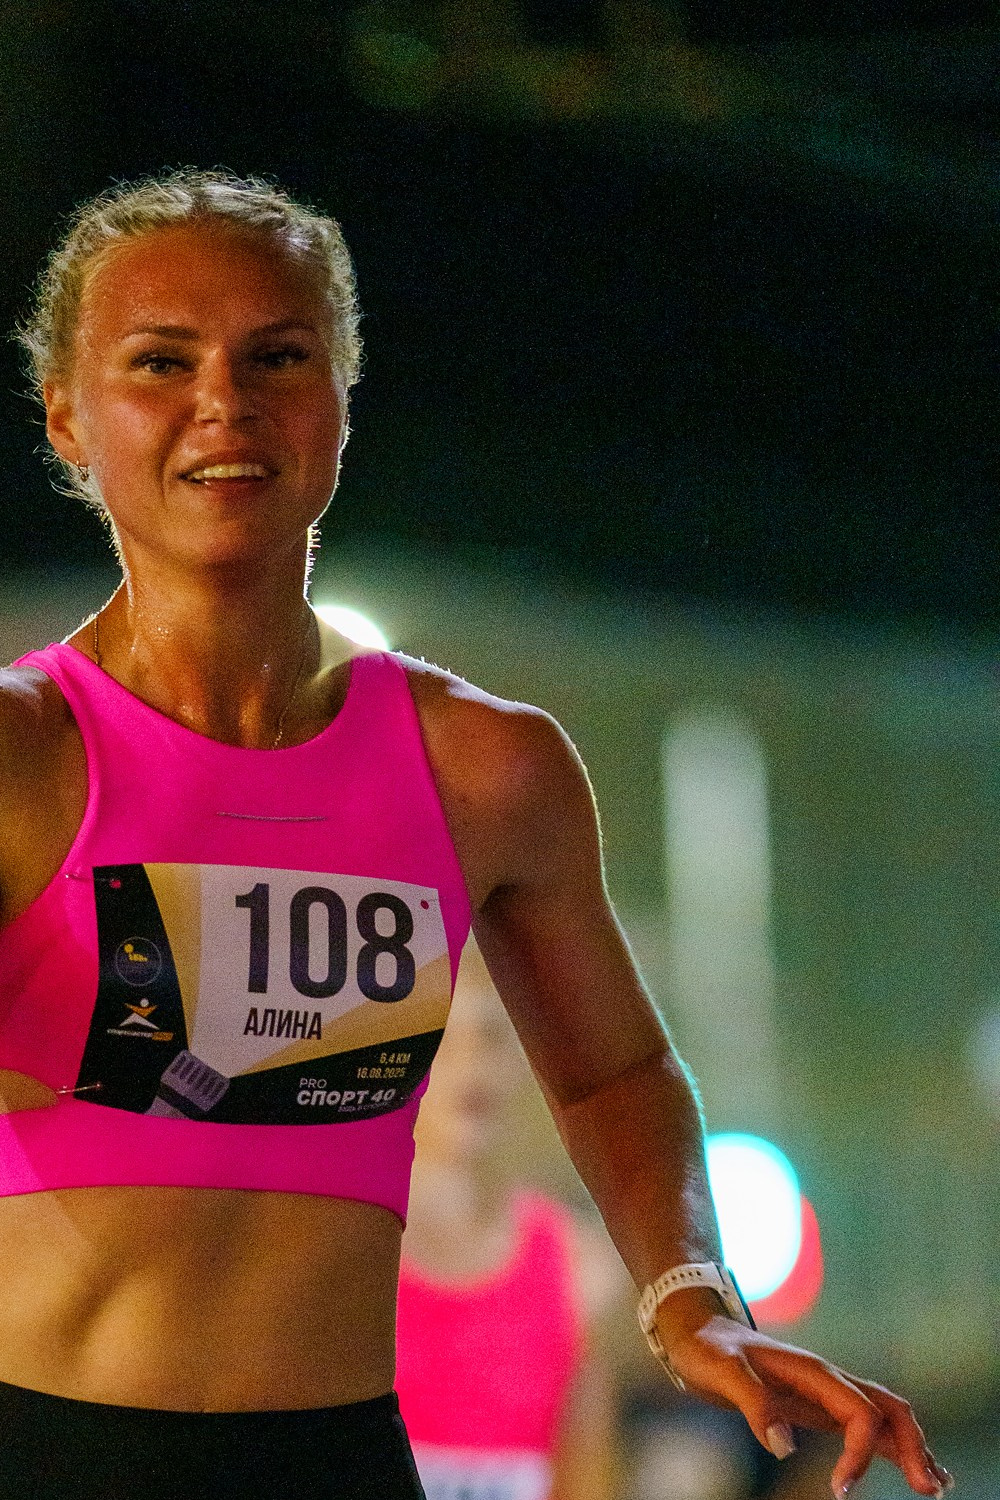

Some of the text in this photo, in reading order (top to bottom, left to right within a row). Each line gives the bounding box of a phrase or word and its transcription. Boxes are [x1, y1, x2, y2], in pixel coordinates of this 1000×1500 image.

[235, 882, 416, 1003] 108
[243, 1007, 322, 1040] АЛИНА
[299, 1078, 327, 1089] PRO
[297, 1088, 397, 1106] СПОРТ 40
